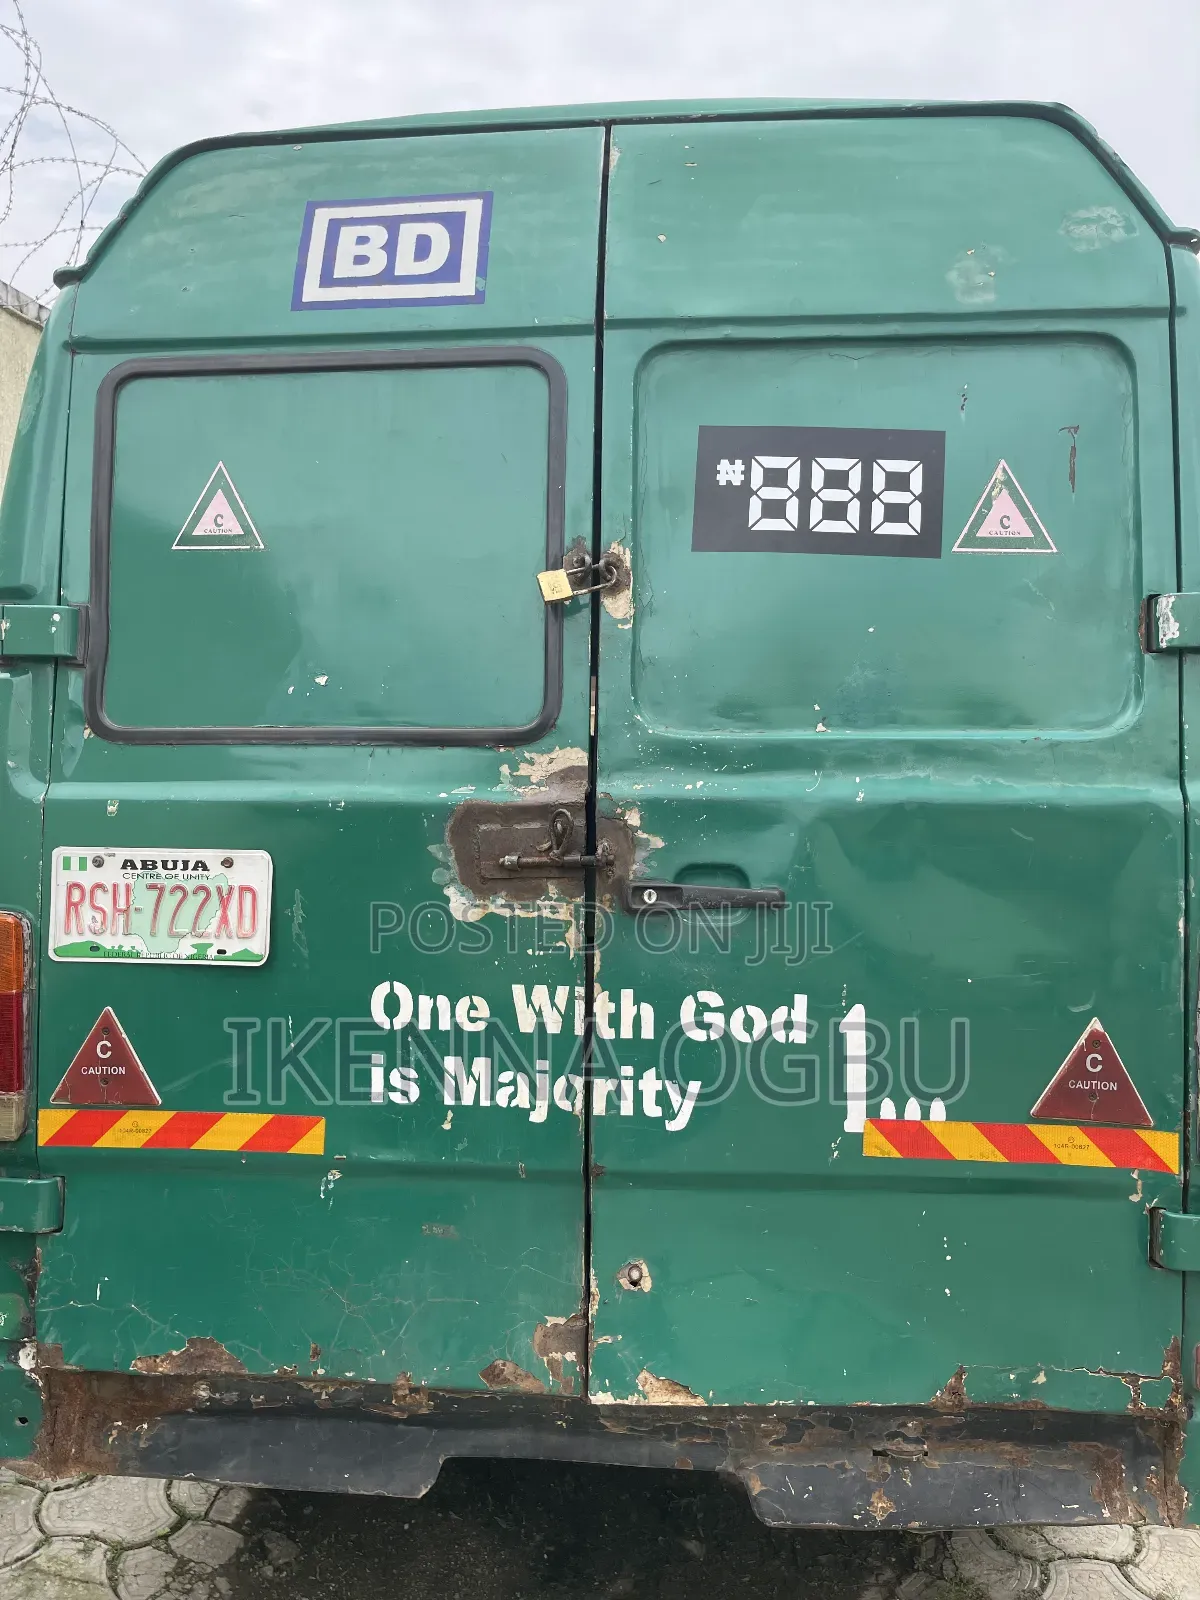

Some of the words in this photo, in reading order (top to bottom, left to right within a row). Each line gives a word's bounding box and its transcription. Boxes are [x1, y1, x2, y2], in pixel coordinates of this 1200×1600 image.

[333, 222, 450, 279] BD
[213, 513, 224, 528] C
[999, 514, 1011, 530] C
[120, 858, 210, 871] ABUJA
[122, 872, 162, 880] CENTRE
[182, 873, 211, 881] UNITY
[64, 881, 258, 939] RSH-722XD
[370, 980, 491, 1031] One
[512, 984, 655, 1040] With
[680, 990, 808, 1043] God
[96, 1040, 112, 1059] C
[81, 1066, 126, 1075] CAUTION
[1085, 1053, 1103, 1073] C
[371, 1053, 420, 1104] is
[443, 1056, 702, 1132] Majority
[1068, 1079, 1118, 1091] CAUTION
